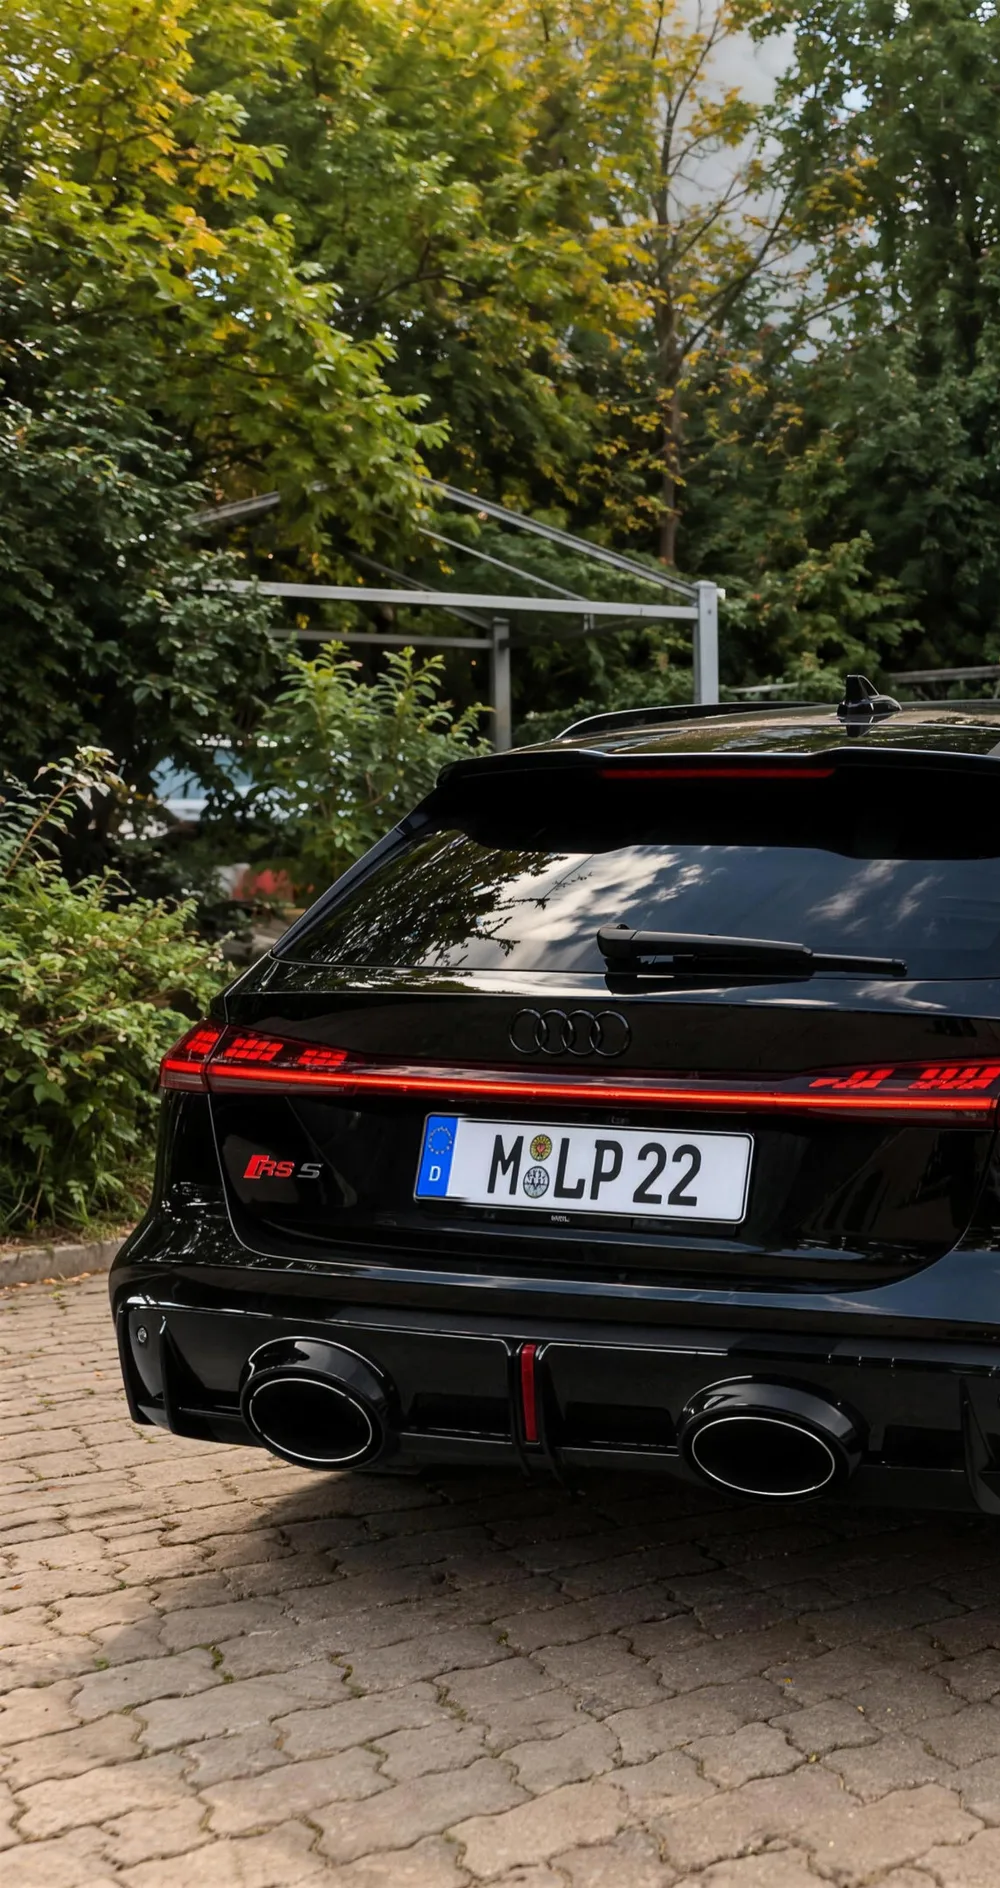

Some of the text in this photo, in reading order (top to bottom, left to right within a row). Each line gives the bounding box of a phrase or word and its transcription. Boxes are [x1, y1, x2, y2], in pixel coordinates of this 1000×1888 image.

[428, 1165, 441, 1182] D
[487, 1134, 702, 1207] M LP 22
